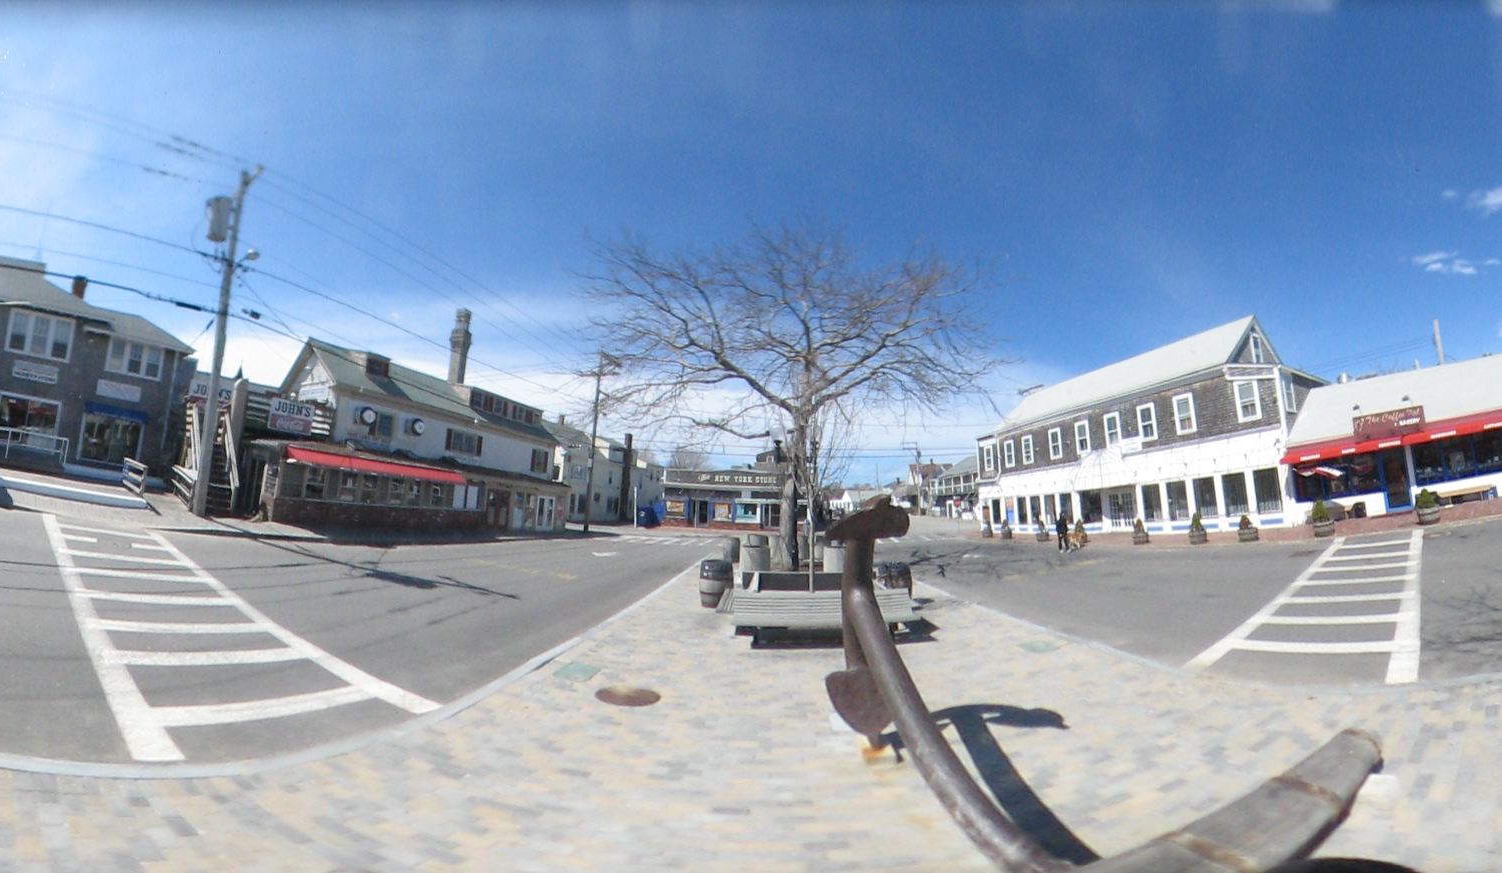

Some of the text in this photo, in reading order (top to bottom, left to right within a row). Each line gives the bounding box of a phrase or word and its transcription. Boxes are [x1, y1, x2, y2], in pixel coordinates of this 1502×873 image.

[274, 401, 311, 418] JOHN'S
[733, 475, 753, 483] YORK
[755, 476, 778, 484] STORE
